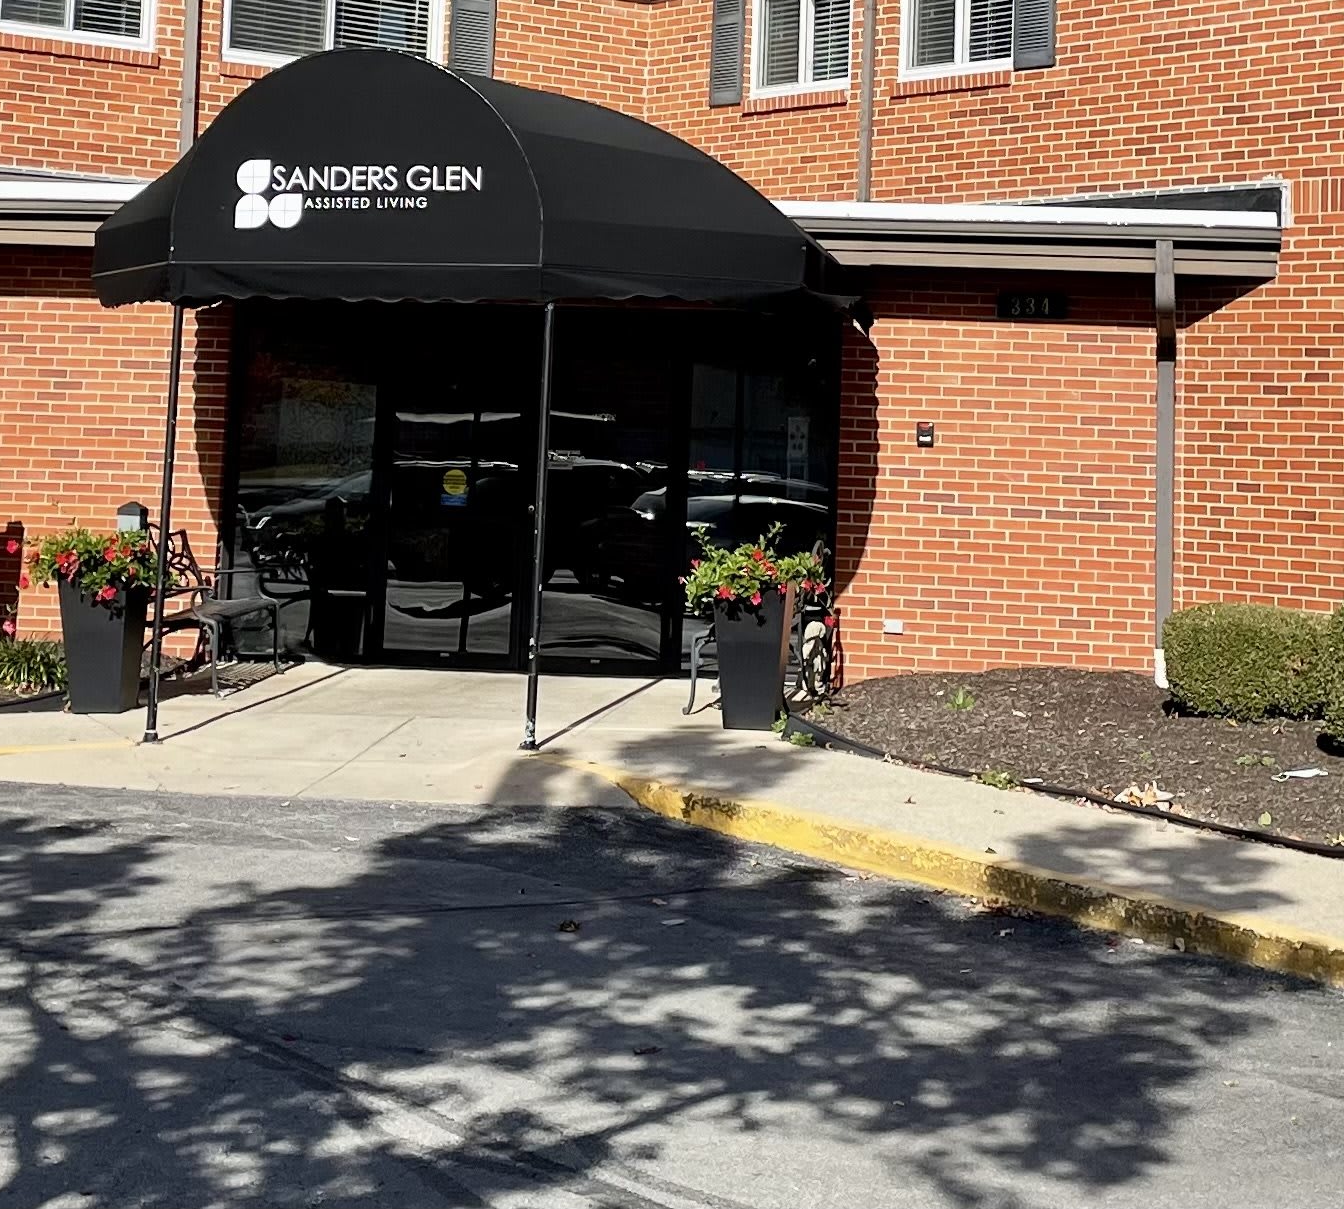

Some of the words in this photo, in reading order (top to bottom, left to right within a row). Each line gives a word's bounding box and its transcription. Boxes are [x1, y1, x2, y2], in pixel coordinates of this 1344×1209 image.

[272, 165, 397, 192] SANDERS
[406, 165, 482, 192] GLEN
[304, 196, 370, 209] ASSISTED
[377, 196, 428, 209] LIVING
